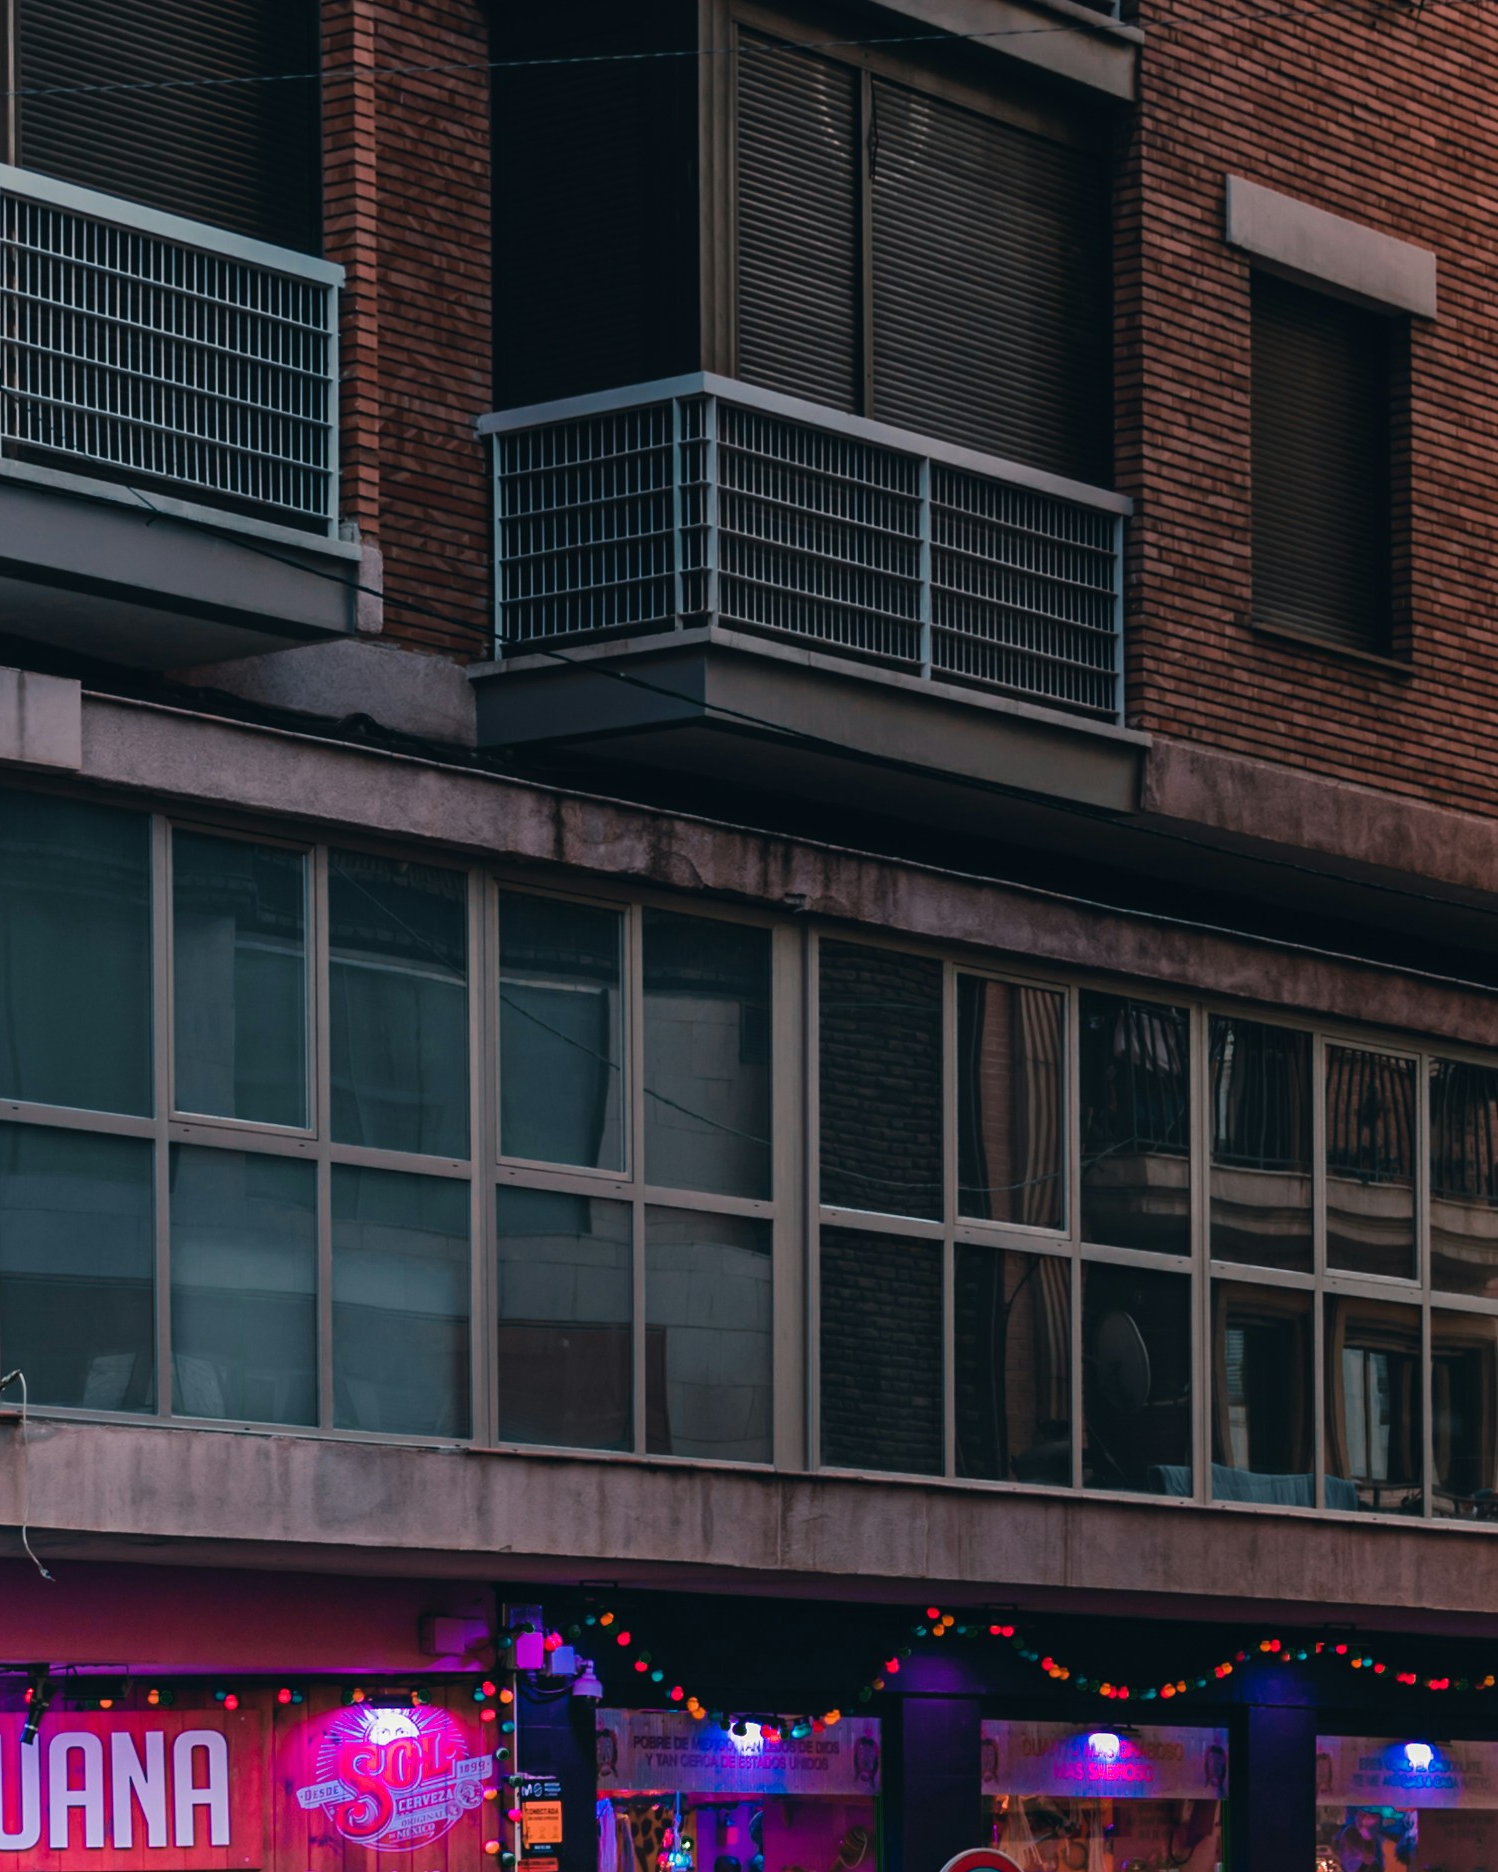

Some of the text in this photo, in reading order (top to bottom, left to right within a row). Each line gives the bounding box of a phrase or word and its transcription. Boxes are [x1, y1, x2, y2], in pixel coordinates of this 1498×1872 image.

[633, 1735, 671, 1750] POBRE
[674, 1736, 689, 1750] DE
[645, 1753, 829, 1770] Y TAN CERCA DE ESTADOS UNIDOS
[303, 1784, 340, 1801] DESDE
[336, 1732, 455, 1837] SOL
[398, 1788, 454, 1812] CERVEZA
